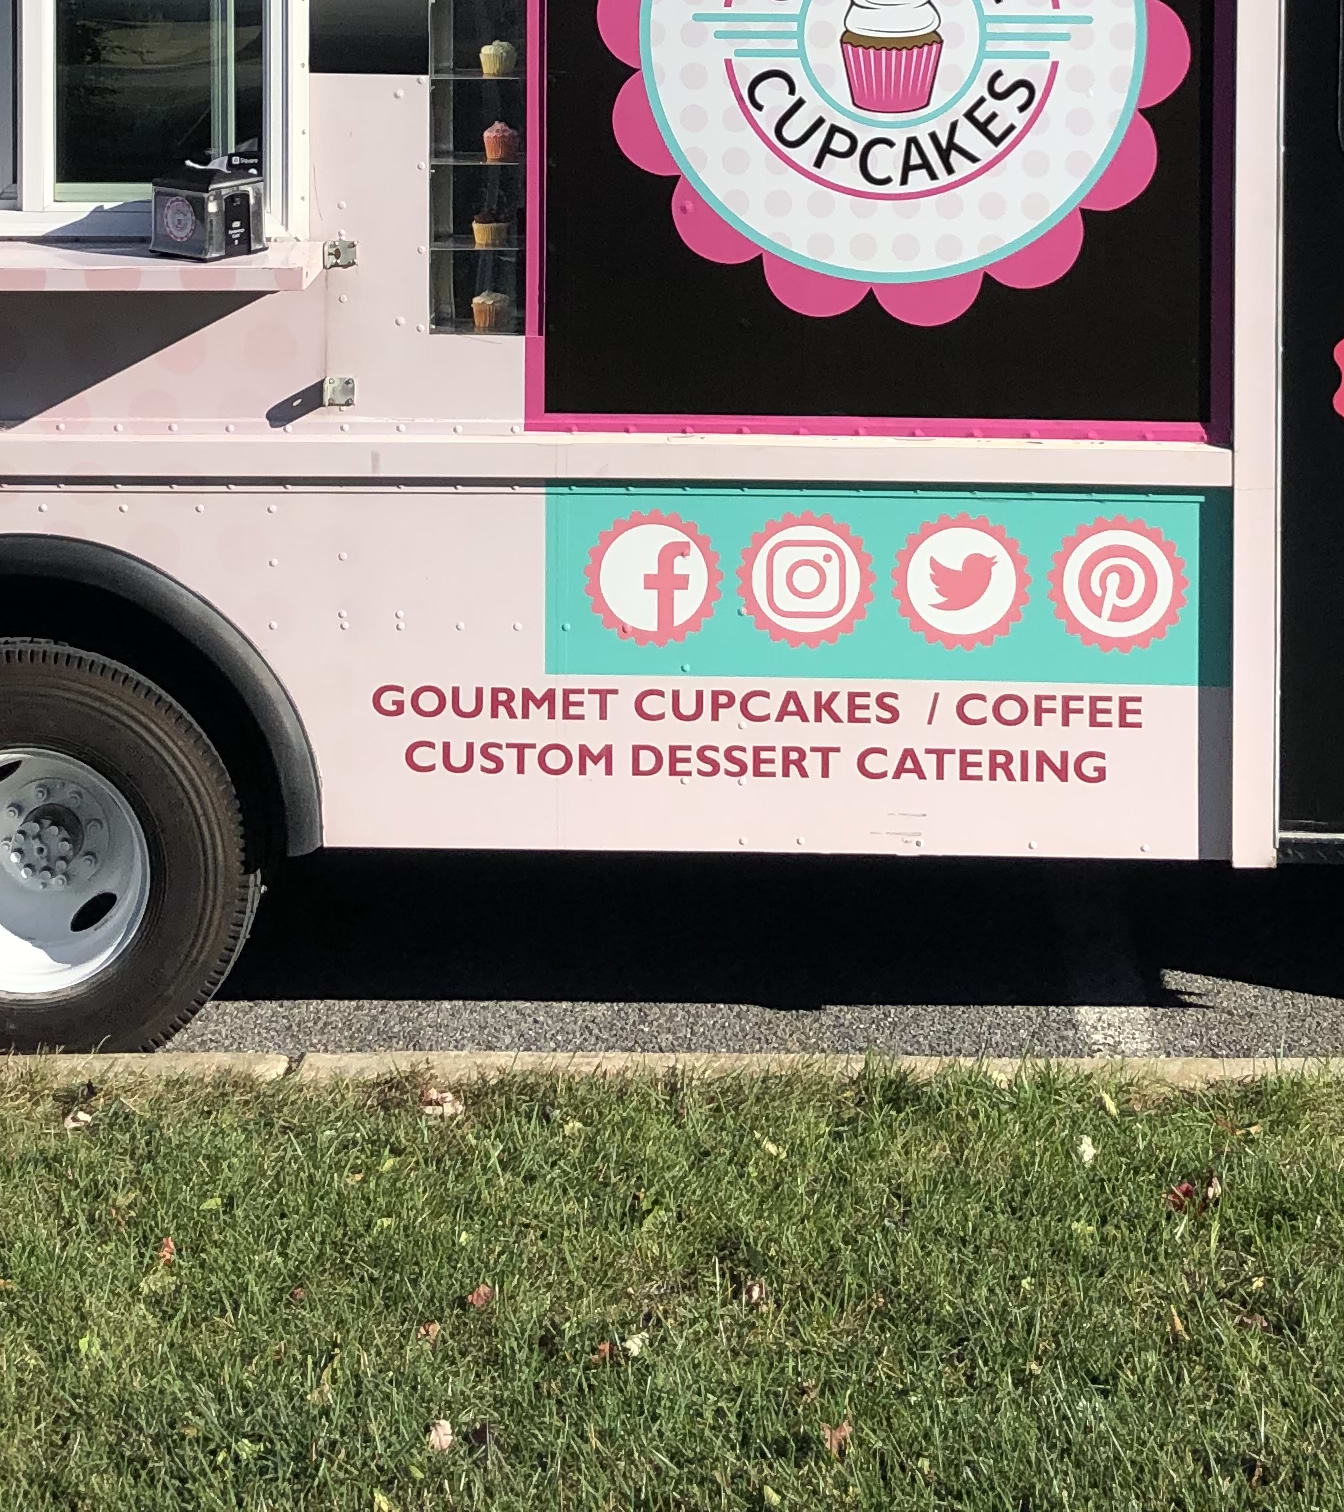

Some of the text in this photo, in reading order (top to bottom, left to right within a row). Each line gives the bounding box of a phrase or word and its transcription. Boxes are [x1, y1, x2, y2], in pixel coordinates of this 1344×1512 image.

[746, 68, 1036, 187] CUPCAKES
[371, 685, 1142, 729] GOURMET CUPCAKES / COFFEE
[404, 741, 1106, 783] CUSTOM DESSERT CATERING
